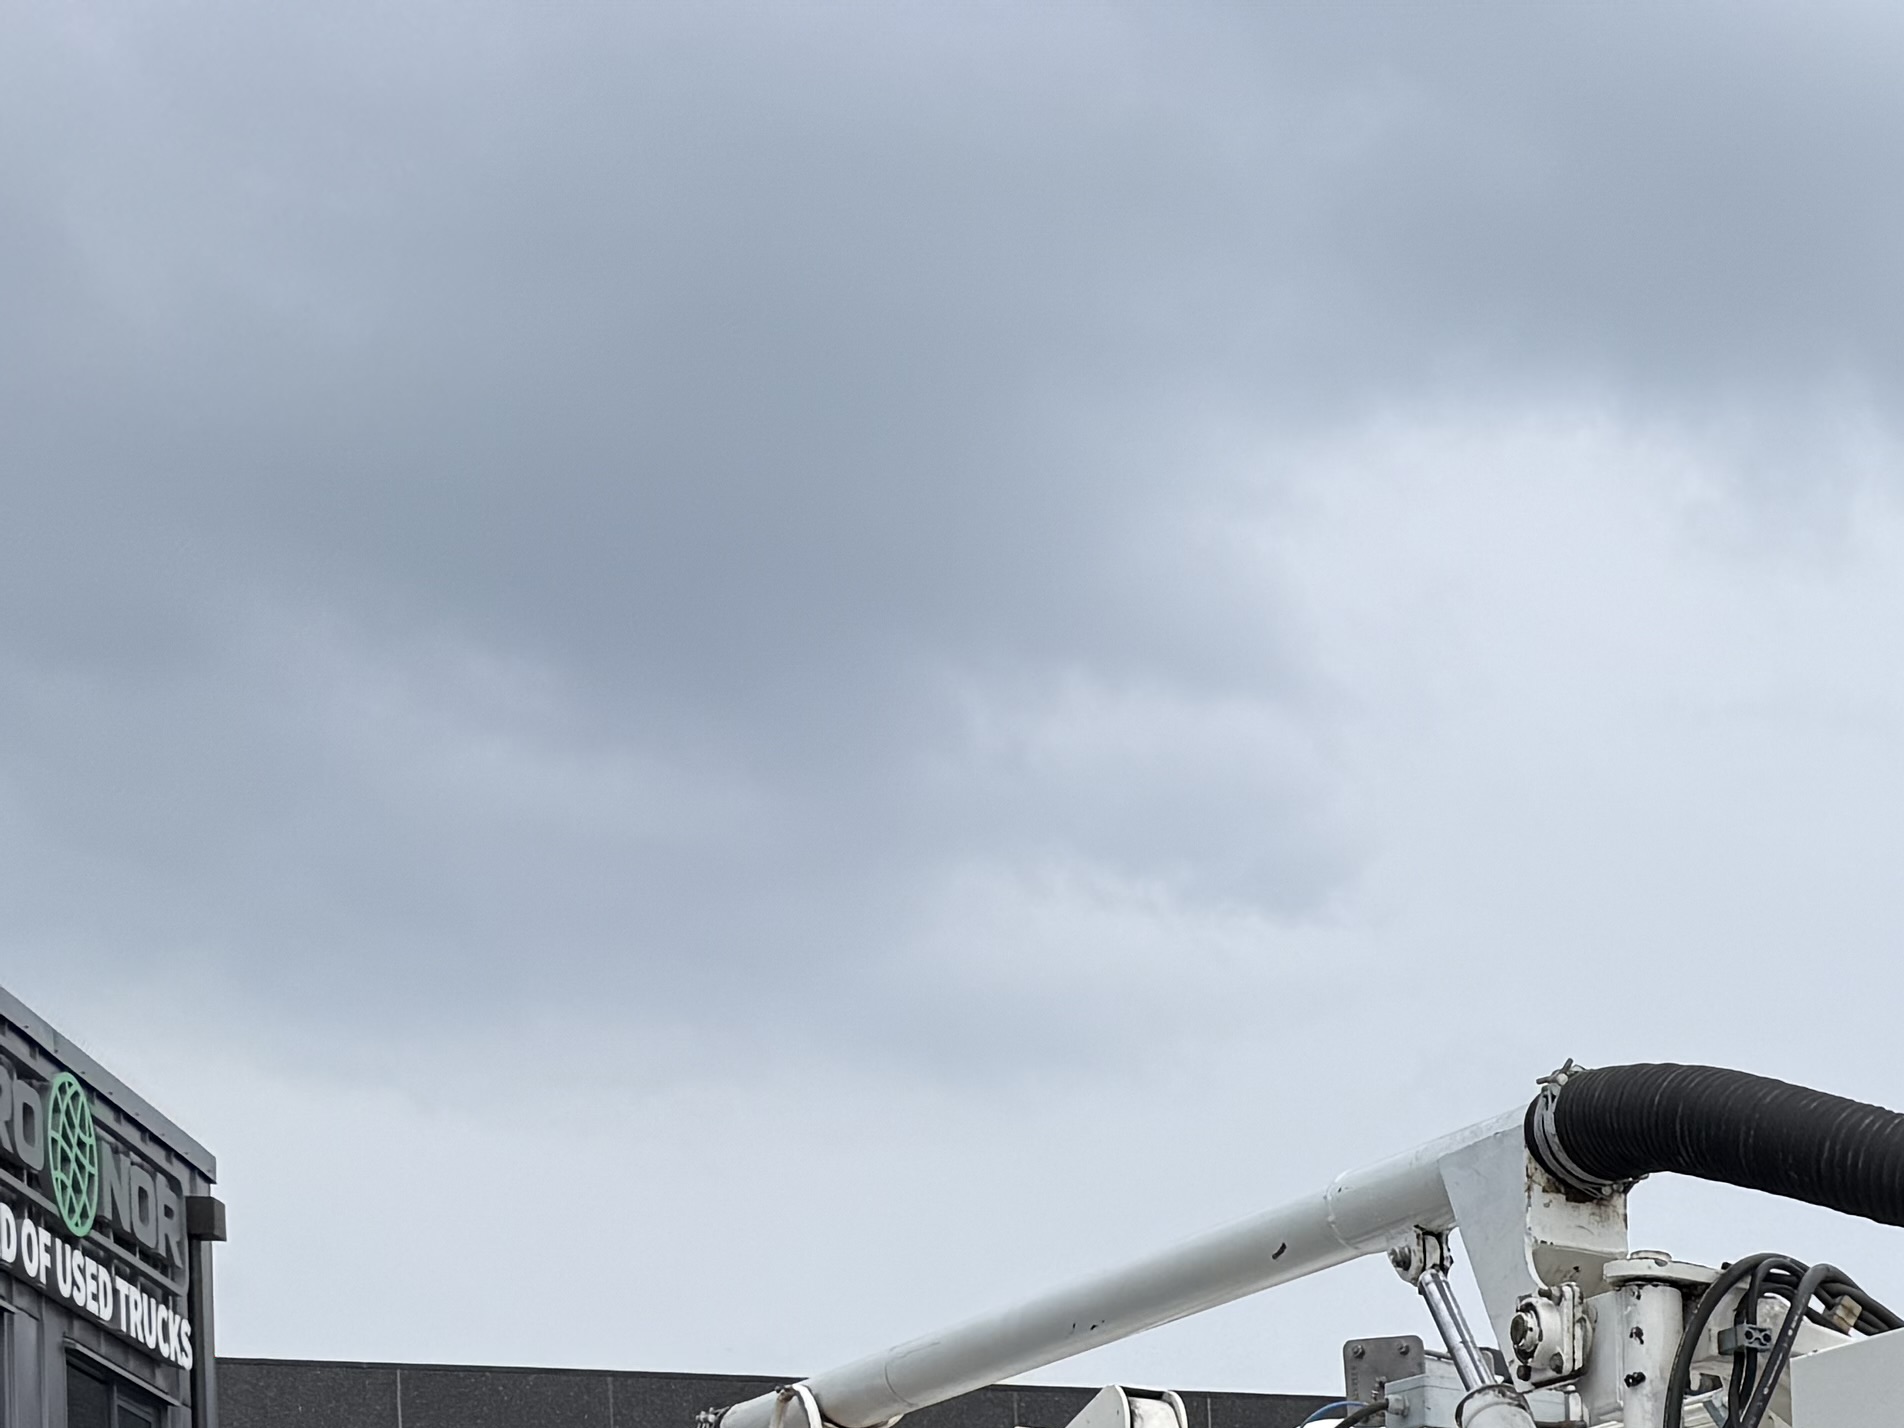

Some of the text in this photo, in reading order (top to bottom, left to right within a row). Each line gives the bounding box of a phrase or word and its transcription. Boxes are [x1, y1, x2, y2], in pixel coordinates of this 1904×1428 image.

[101, 1142, 182, 1269] NOR
[21, 1218, 52, 1285] OF
[56, 1238, 114, 1322] USED
[114, 1281, 193, 1371] TRUCKS
